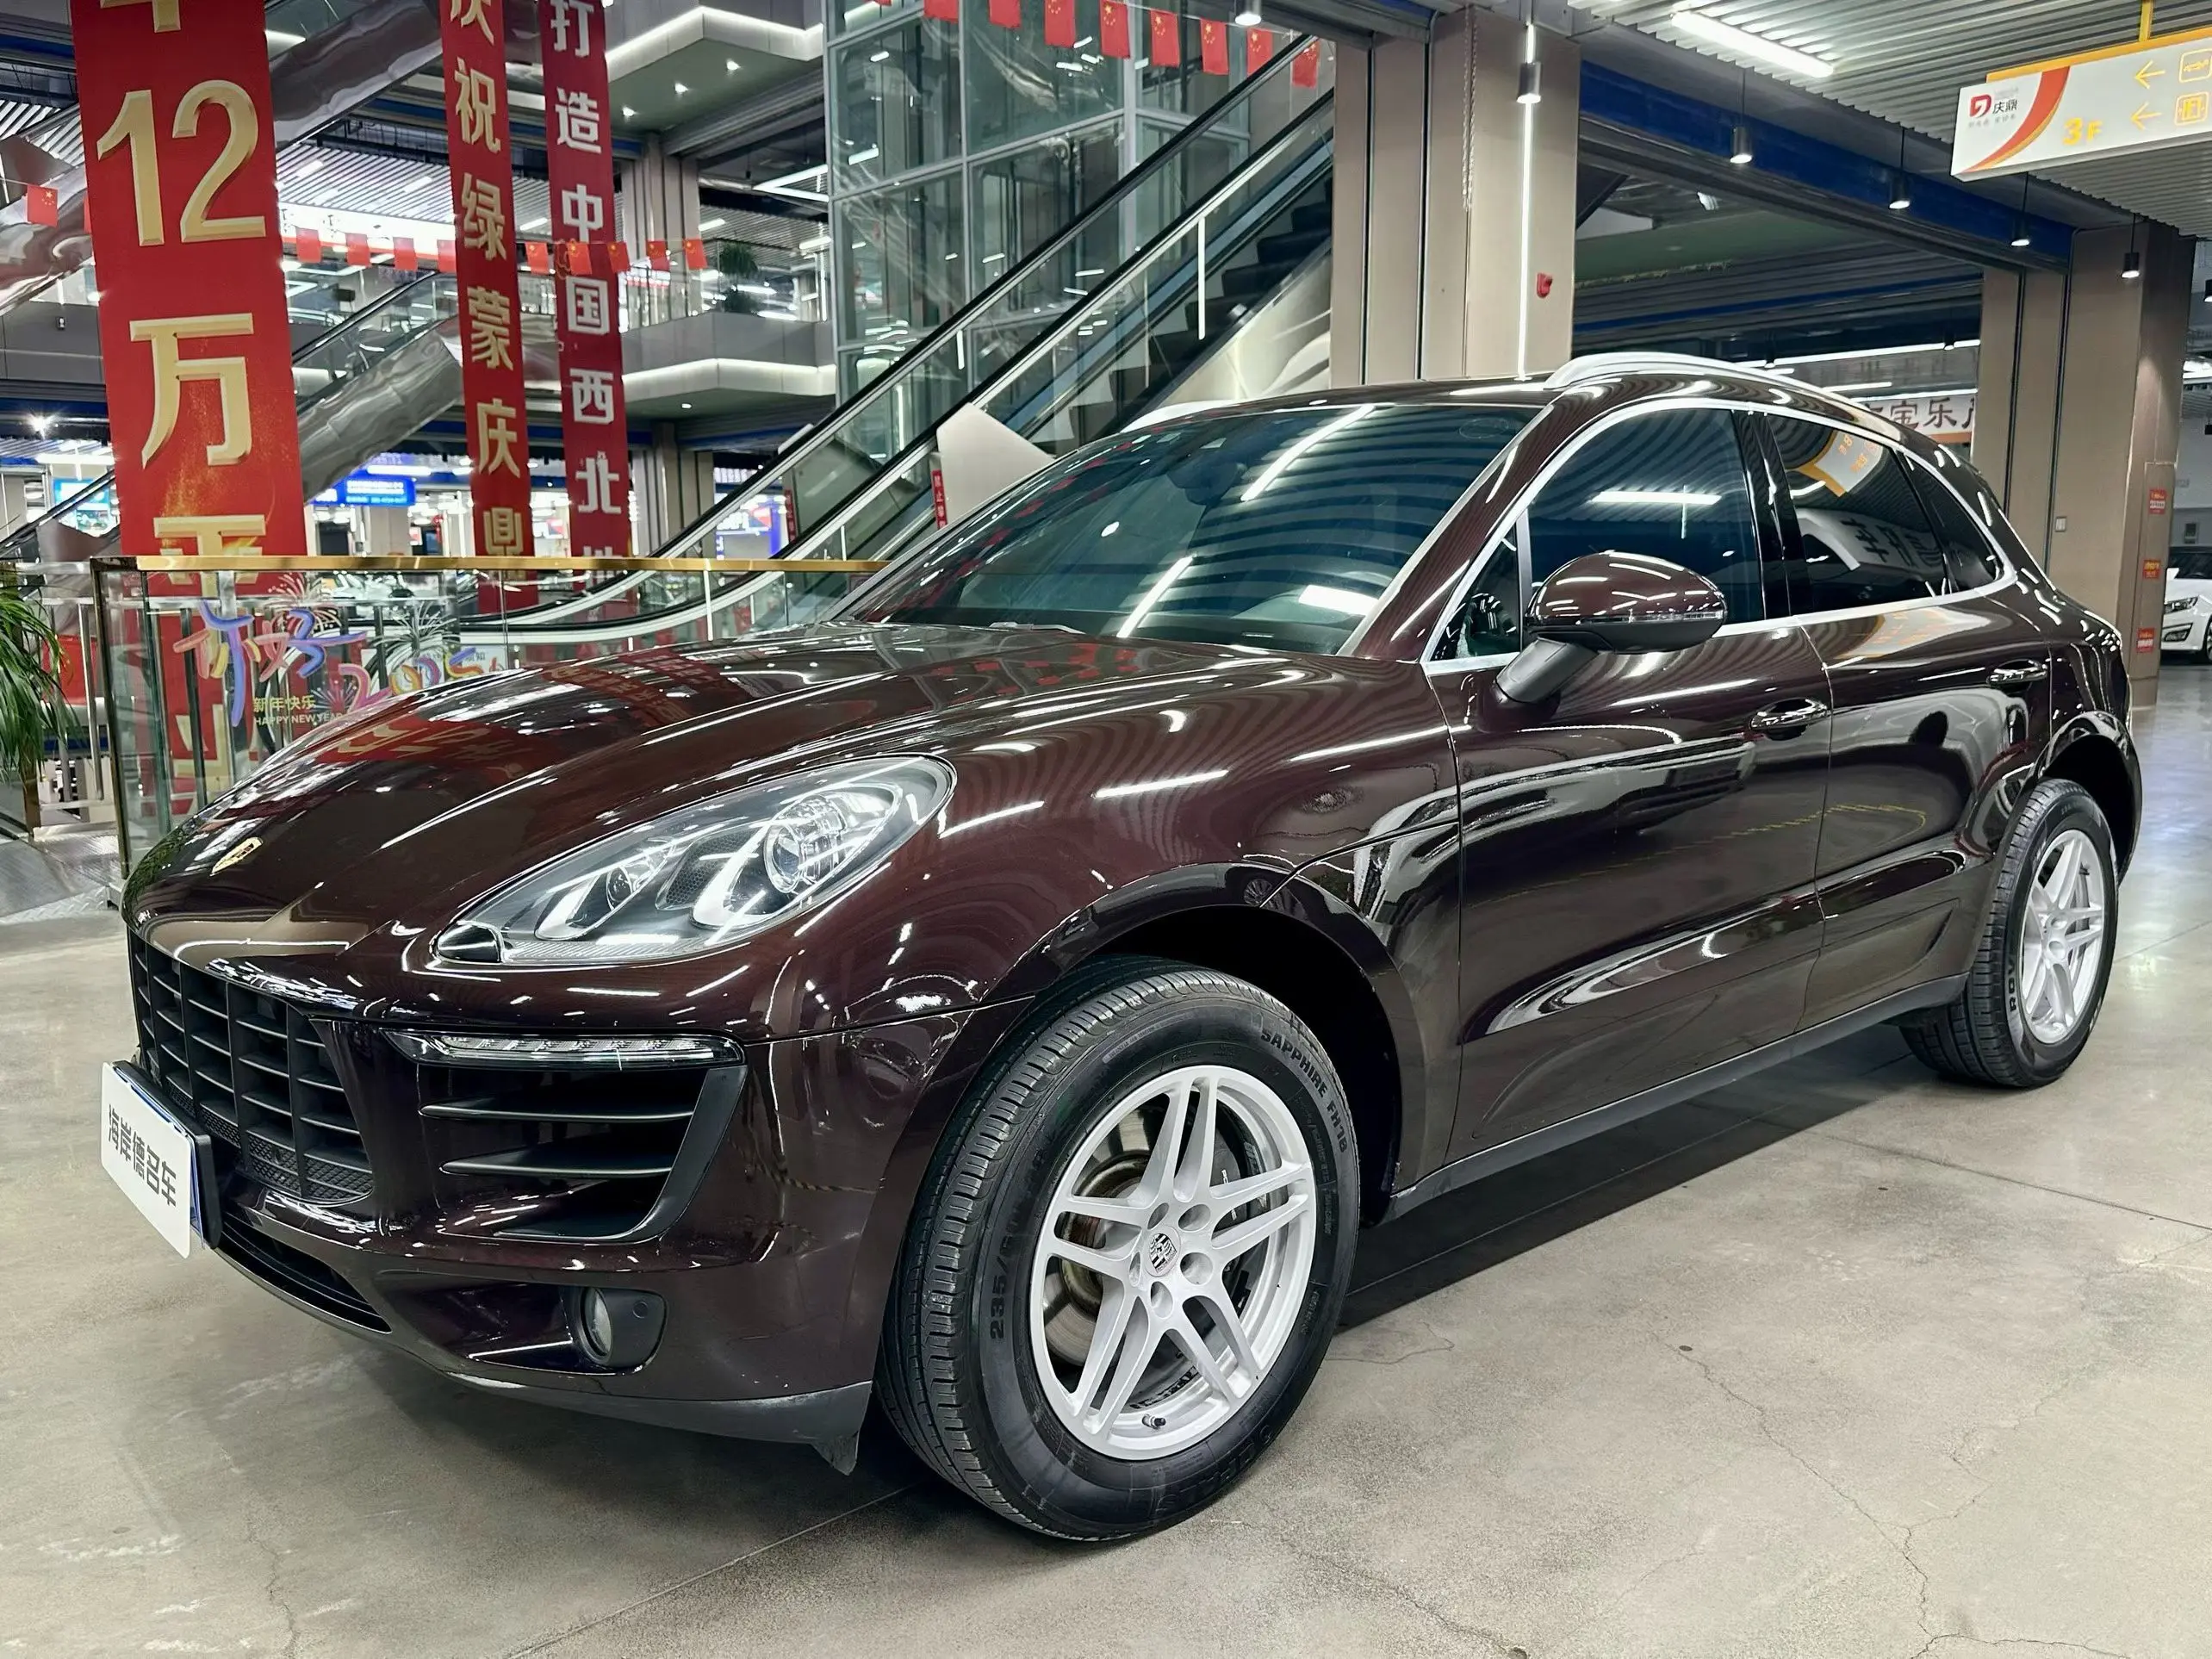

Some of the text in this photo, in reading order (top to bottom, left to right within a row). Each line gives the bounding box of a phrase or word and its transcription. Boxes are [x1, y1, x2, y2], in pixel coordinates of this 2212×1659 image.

[1864, 397, 1974, 430] 宝乐
[252, 694, 316, 713] 新年快乐
[255, 716, 289, 726] HAPPY
[291, 714, 315, 724] NEW
[1260, 1029, 1327, 1097] SAPPHIRE
[109, 1103, 177, 1207] 海岸德名车
